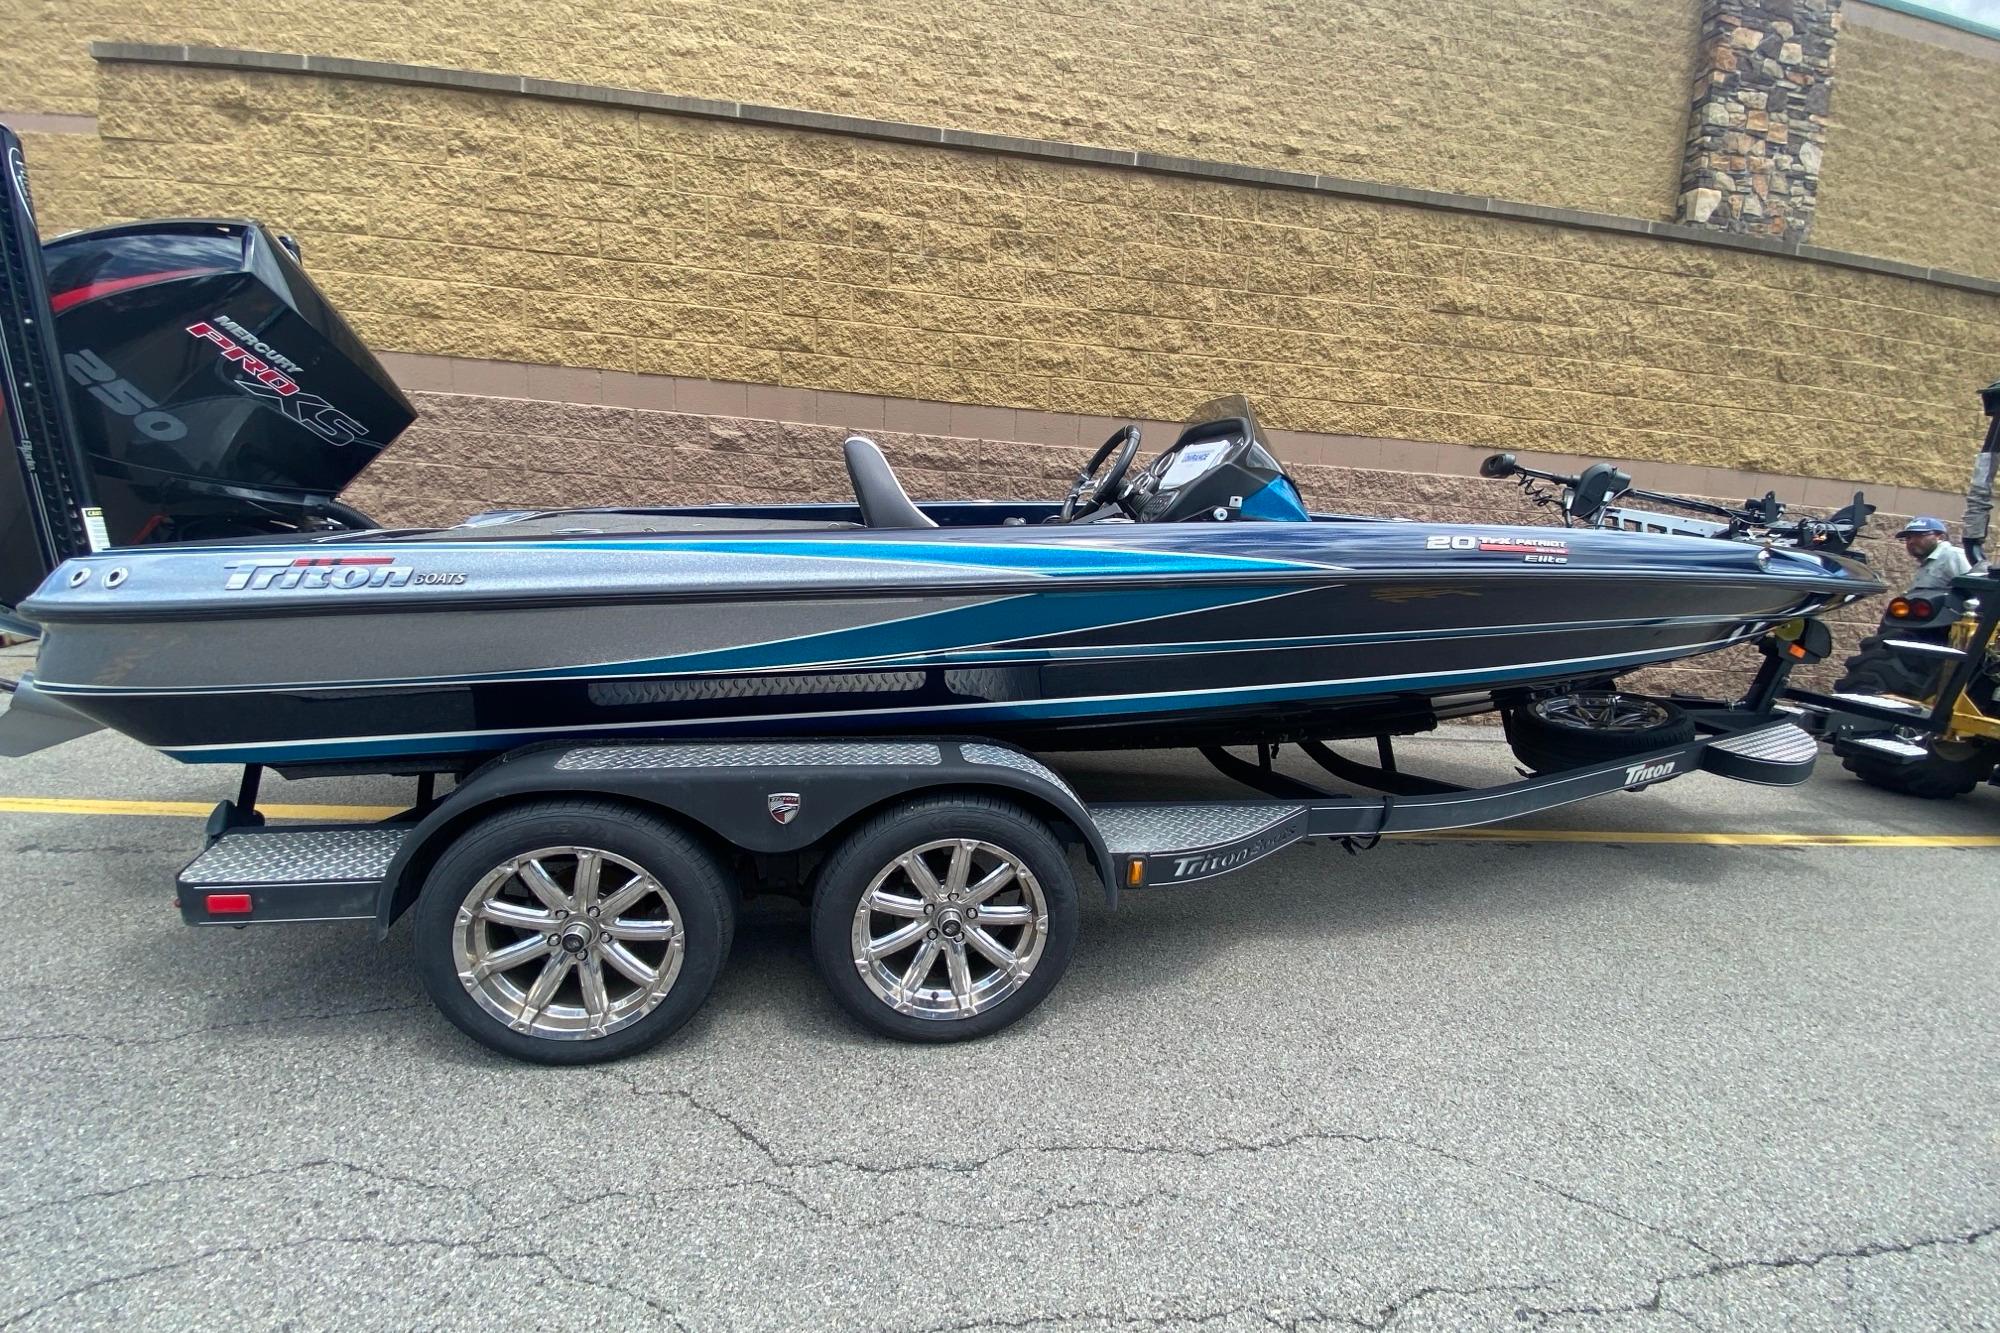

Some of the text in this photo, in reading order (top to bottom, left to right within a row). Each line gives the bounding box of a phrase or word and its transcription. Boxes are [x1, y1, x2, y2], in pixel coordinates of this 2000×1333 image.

[186, 322, 300, 396] PRO
[213, 315, 304, 373] MERCURY
[63, 348, 188, 442] 250
[234, 379, 370, 446] XS
[1426, 535, 1477, 550] 20
[1515, 538, 1568, 548] PATRIOT
[223, 557, 468, 591] Triton BOATS
[1523, 555, 1568, 565] Elite
[1624, 760, 1677, 786] Triton
[1173, 848, 1250, 878] Triton
